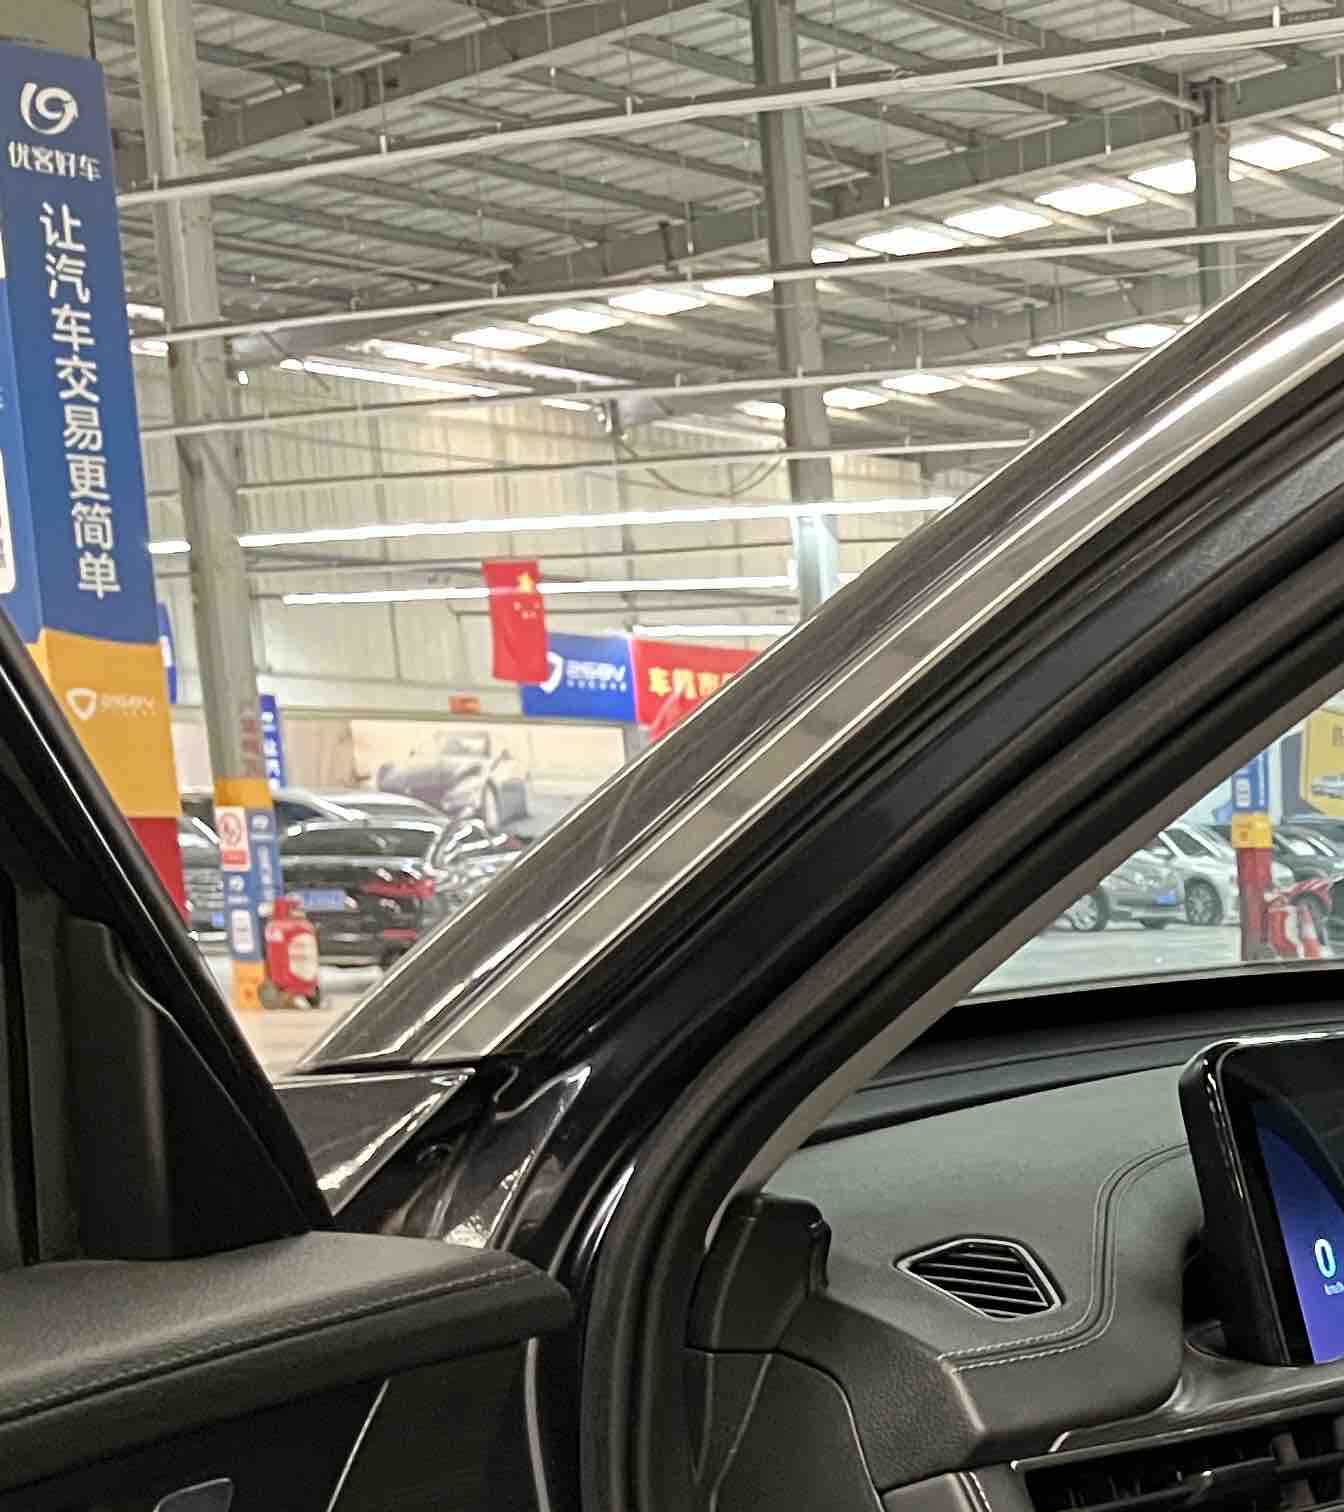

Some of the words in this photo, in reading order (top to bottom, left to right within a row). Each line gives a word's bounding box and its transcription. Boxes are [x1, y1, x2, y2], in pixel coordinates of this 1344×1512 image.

[8, 141, 102, 181] 优客好车
[40, 201, 120, 599] 让汽车交易更简单
[1314, 1238, 1337, 1279] 0
